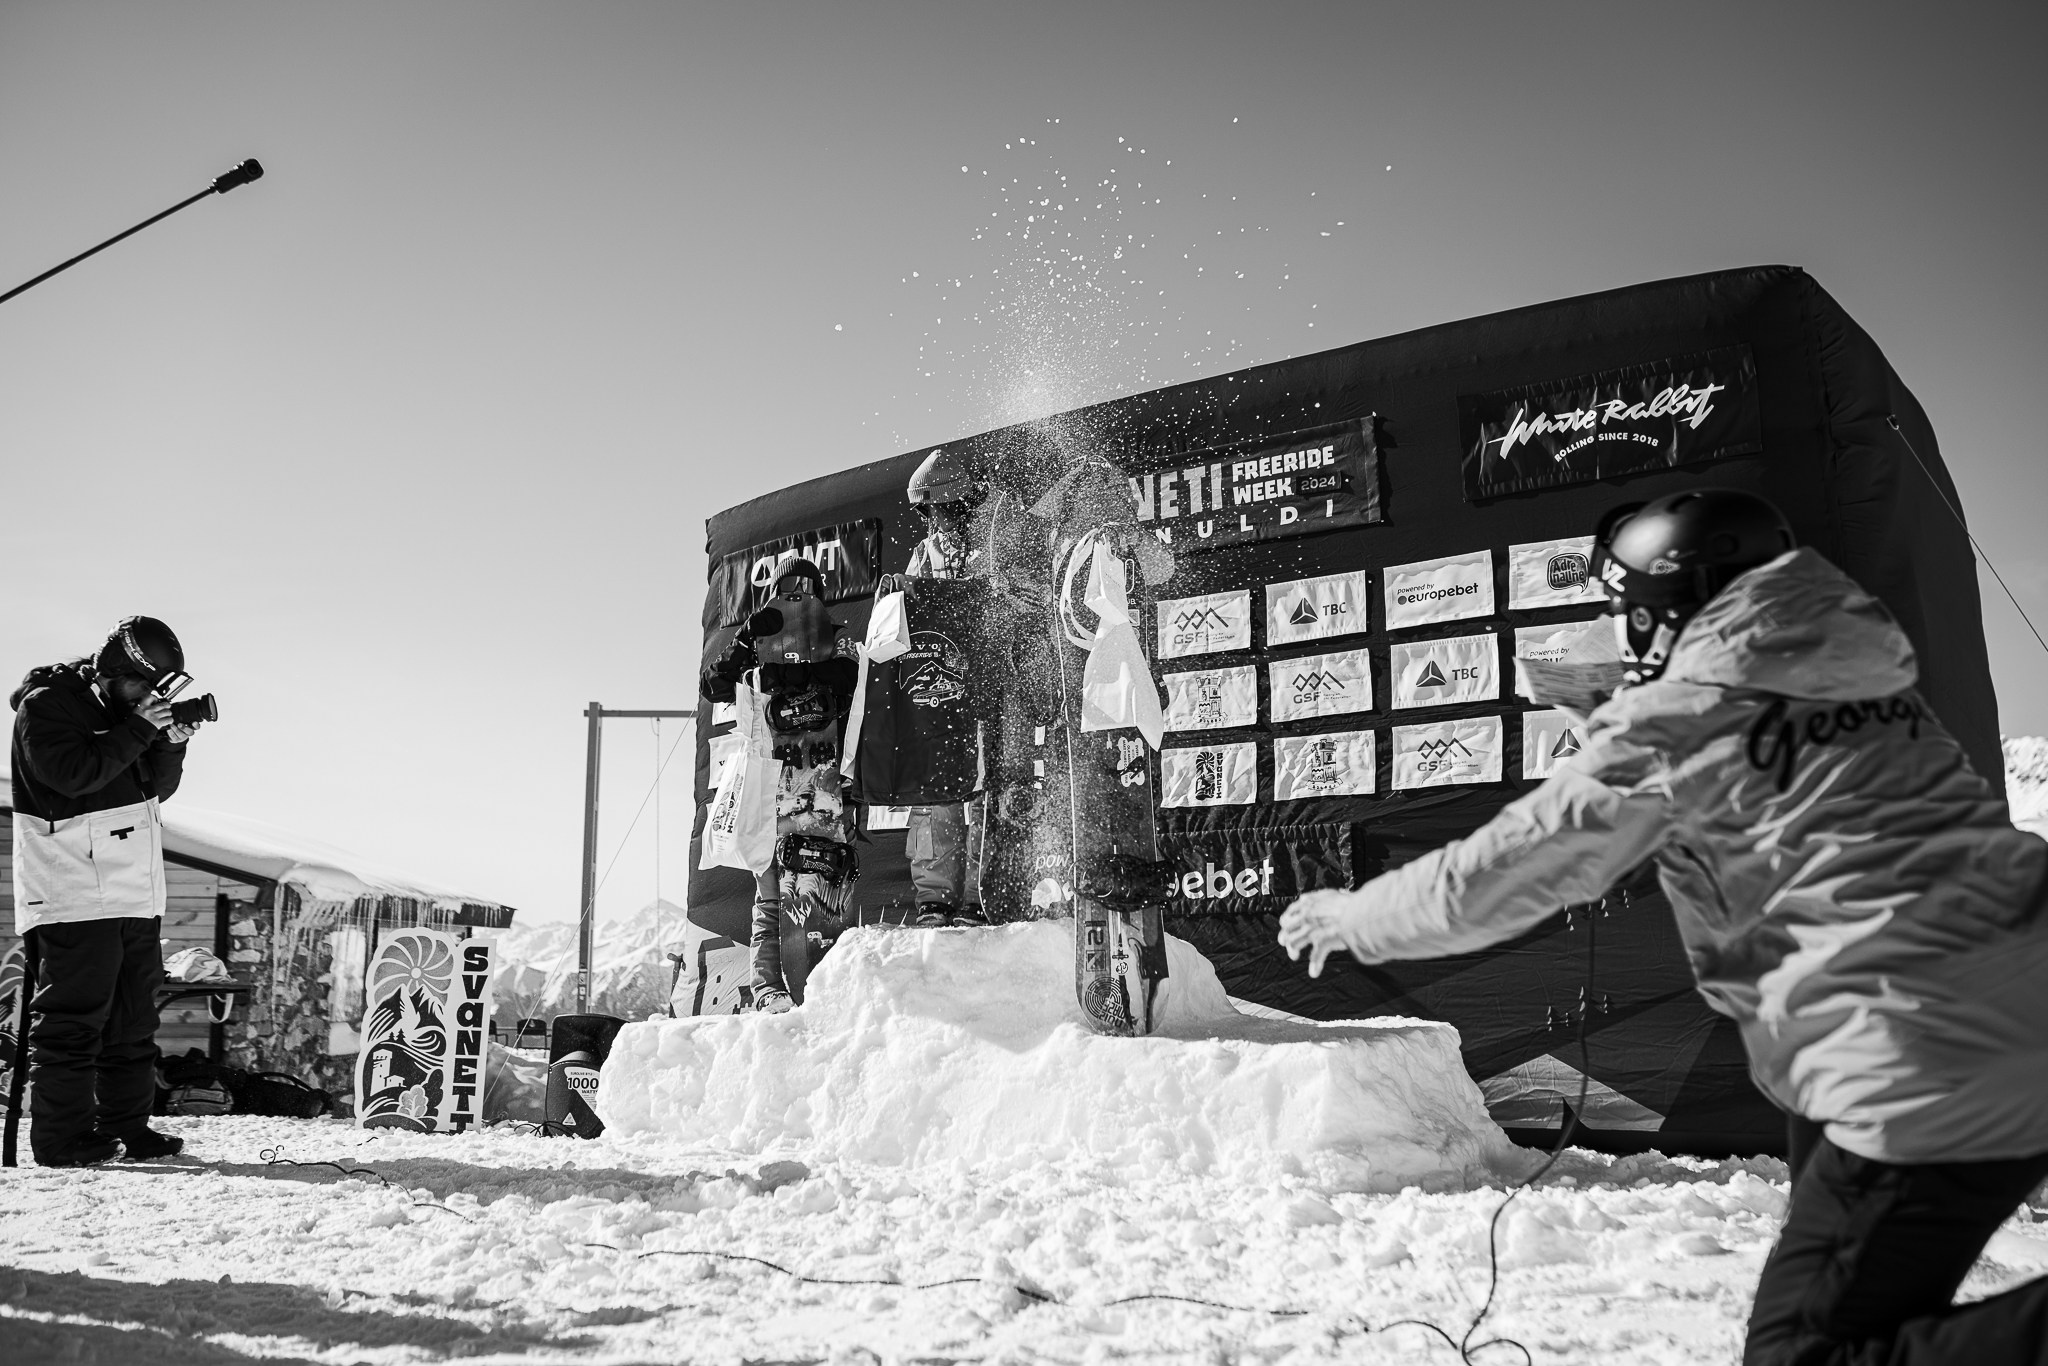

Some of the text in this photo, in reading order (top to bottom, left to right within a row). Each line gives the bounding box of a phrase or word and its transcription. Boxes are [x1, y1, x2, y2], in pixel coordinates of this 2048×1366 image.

[1488, 383, 1725, 460] White Rabbit
[1554, 432, 1660, 463] ROLLING SINCE 2018
[1231, 445, 1335, 483] FREERIDE
[1232, 477, 1337, 505] WEEK 2024
[1397, 583, 1435, 595] powered by
[1408, 582, 1479, 604] europebet
[1322, 602, 1347, 616] TBC
[1174, 631, 1204, 645] GSF
[1529, 647, 1570, 657] powered by
[1452, 666, 1479, 681] TBC
[1293, 691, 1322, 704] GSF
[1417, 759, 1448, 772] GSF
[567, 1077, 599, 1089] 1000
